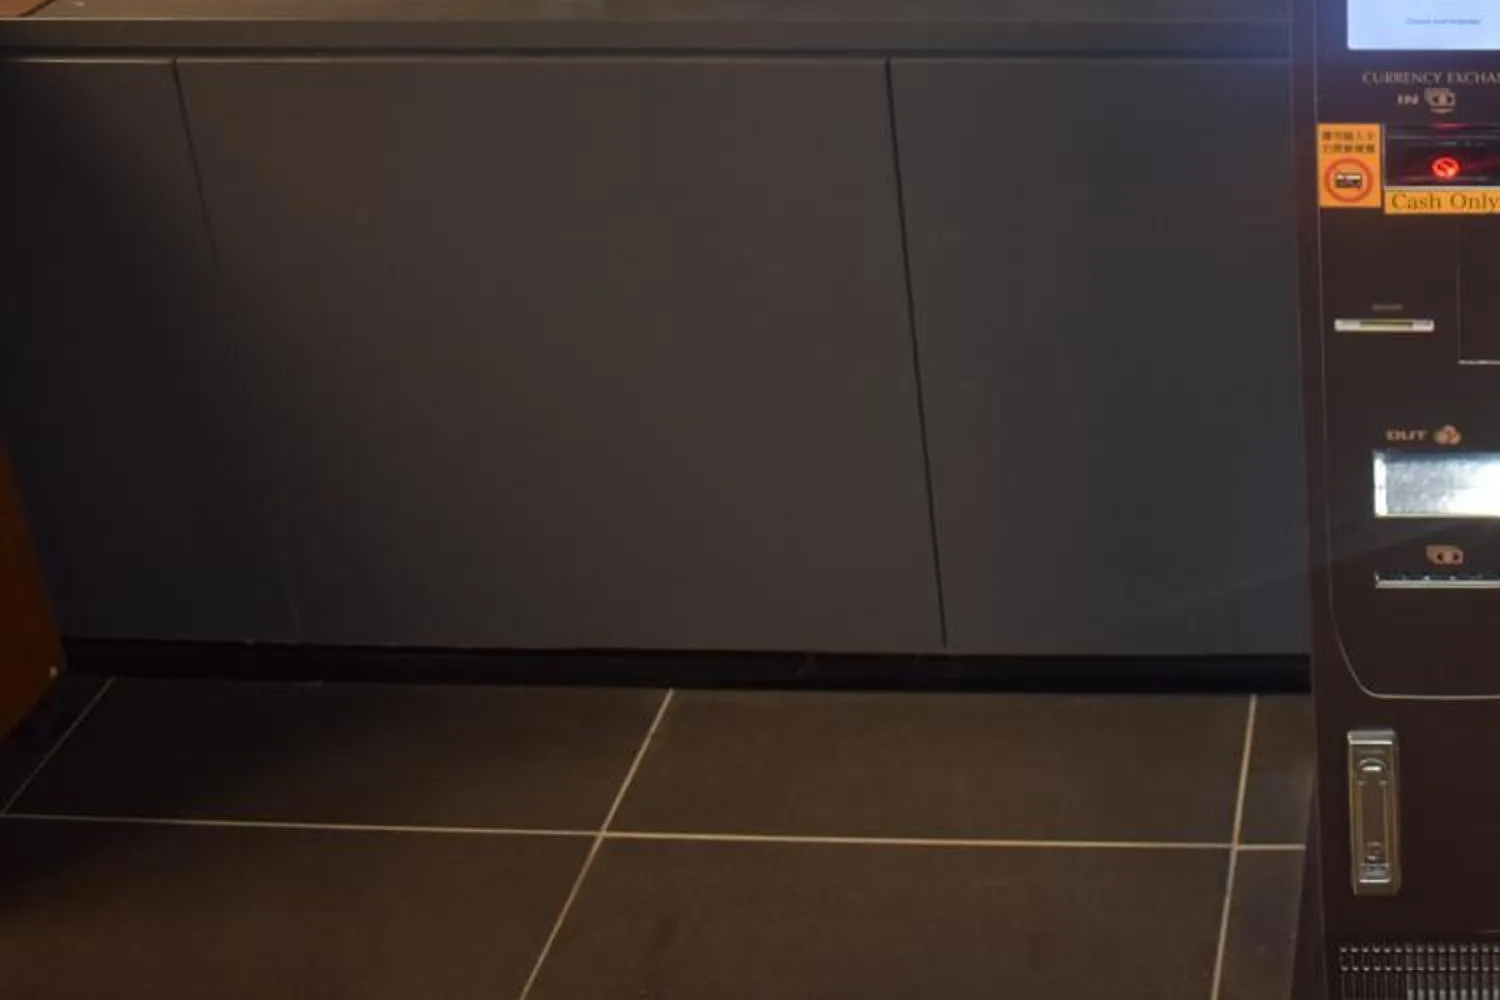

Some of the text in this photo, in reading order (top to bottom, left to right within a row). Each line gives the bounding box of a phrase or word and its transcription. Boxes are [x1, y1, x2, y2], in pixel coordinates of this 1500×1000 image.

[1361, 71, 1441, 85] CURRENCY
[1391, 192, 1500, 212] Cash Only
